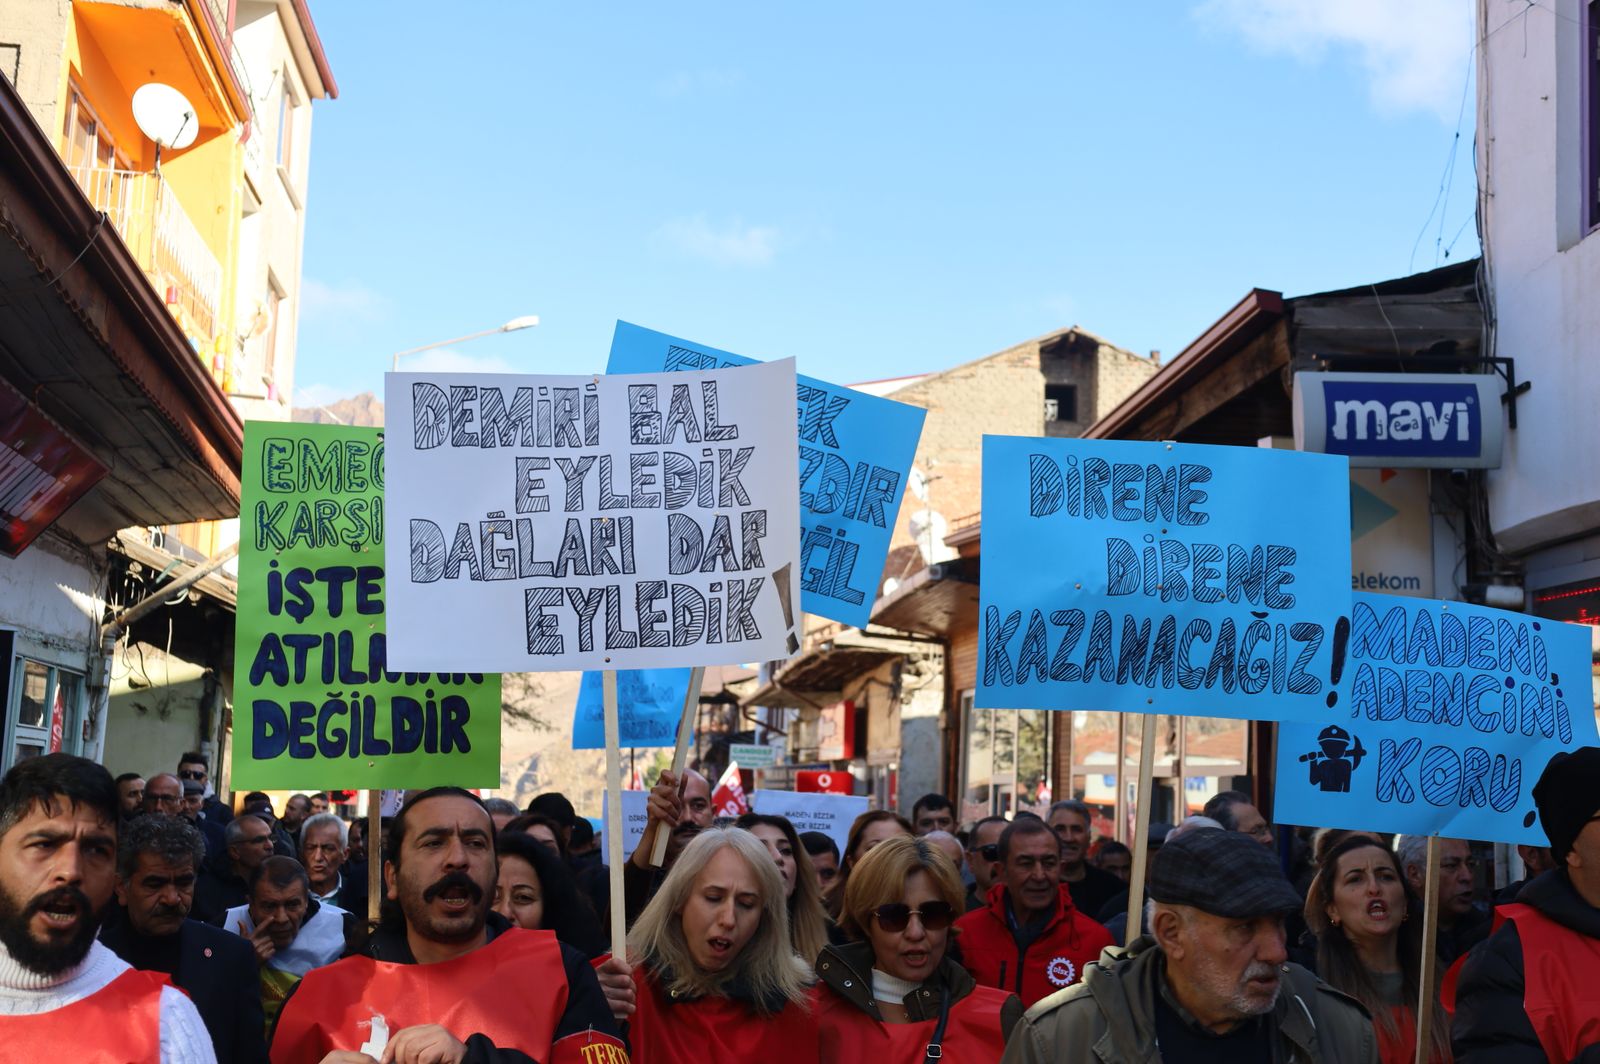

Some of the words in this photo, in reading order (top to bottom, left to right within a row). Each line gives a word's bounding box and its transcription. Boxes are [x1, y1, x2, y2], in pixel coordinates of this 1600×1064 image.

[412, 382, 601, 451] DEMİRİ
[628, 380, 739, 445] BAL
[1333, 399, 1469, 441] mavi
[515, 446, 756, 515] EYLEDİK
[1029, 453, 1213, 527] DİRENE
[409, 511, 637, 584] DAĞLARI
[668, 510, 767, 576] DAR
[800, 525, 866, 606] ĞİL
[1106, 533, 1297, 610] DİRENE
[983, 605, 1351, 709] KAZANACAĞIZ!
[252, 688, 472, 761] DEĞİLDİR
